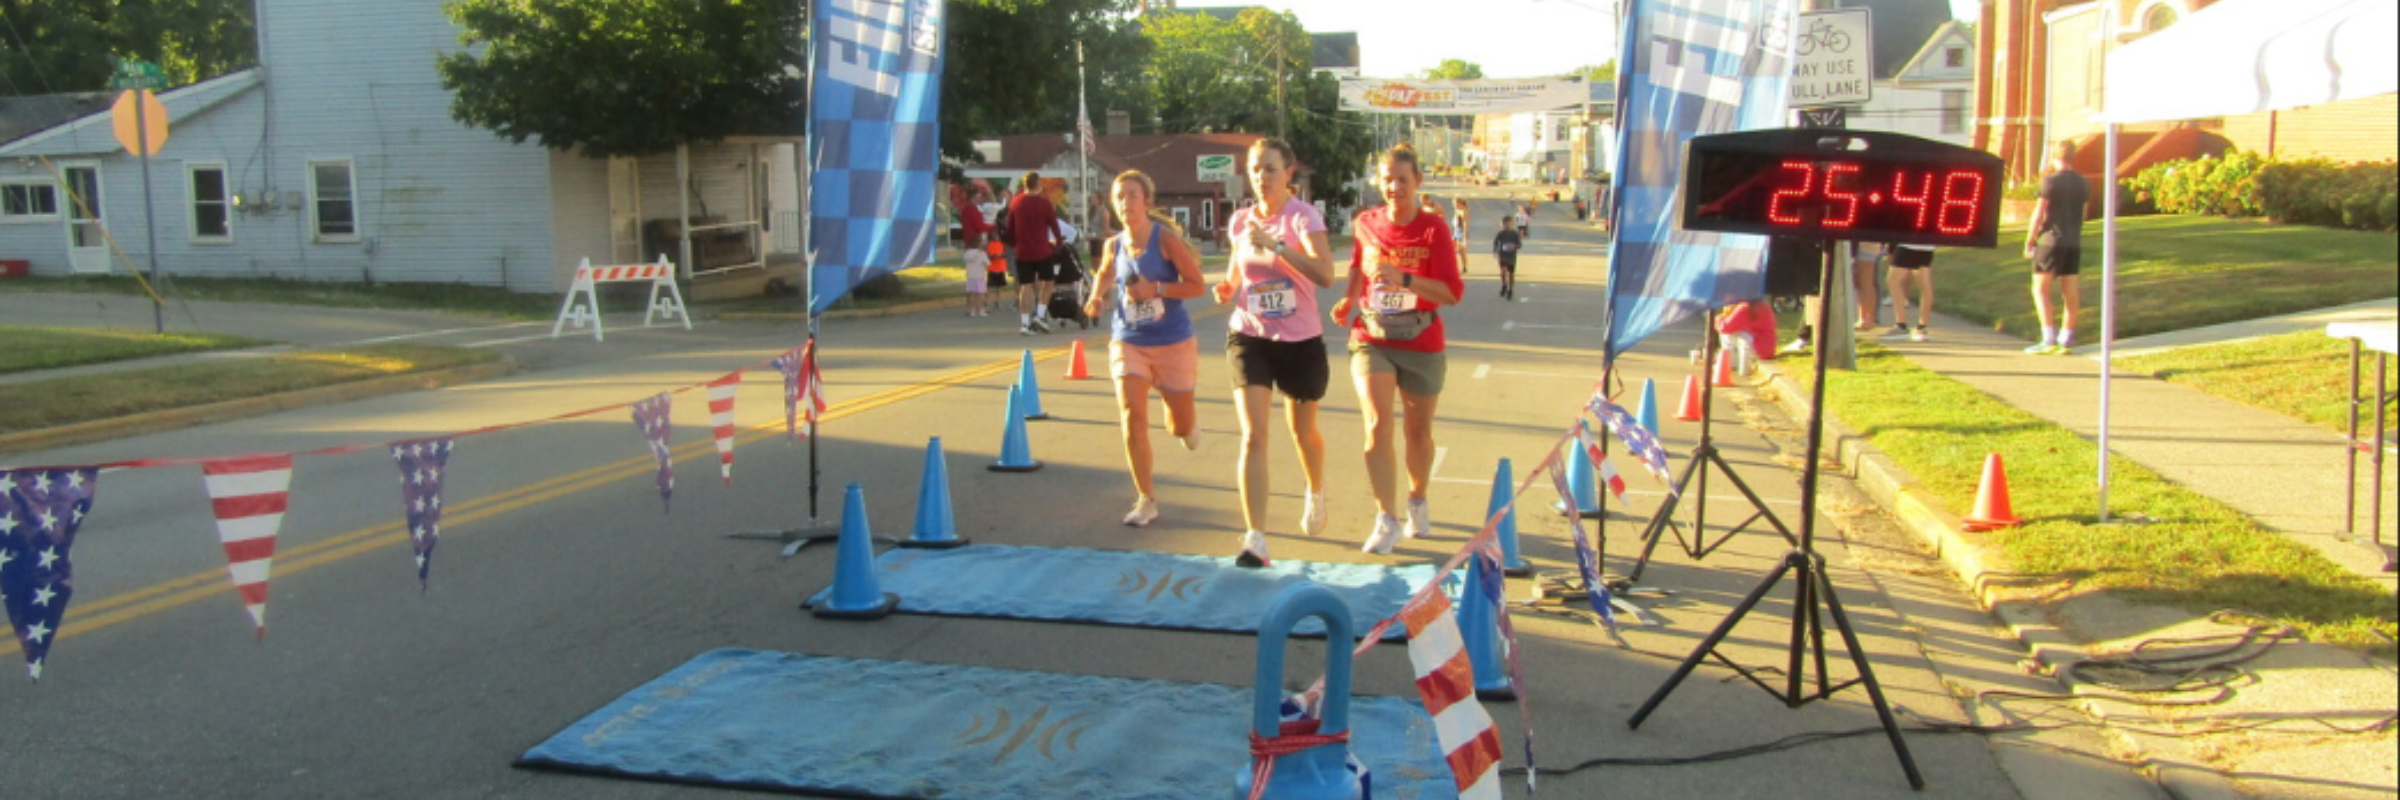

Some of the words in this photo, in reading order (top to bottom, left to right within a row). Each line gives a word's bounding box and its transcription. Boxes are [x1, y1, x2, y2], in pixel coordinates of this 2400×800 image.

[1826, 59, 1855, 75] USE
[1791, 83, 1819, 99] ULL
[1826, 80, 1863, 96] LANE
[1259, 292, 1285, 310] 412
